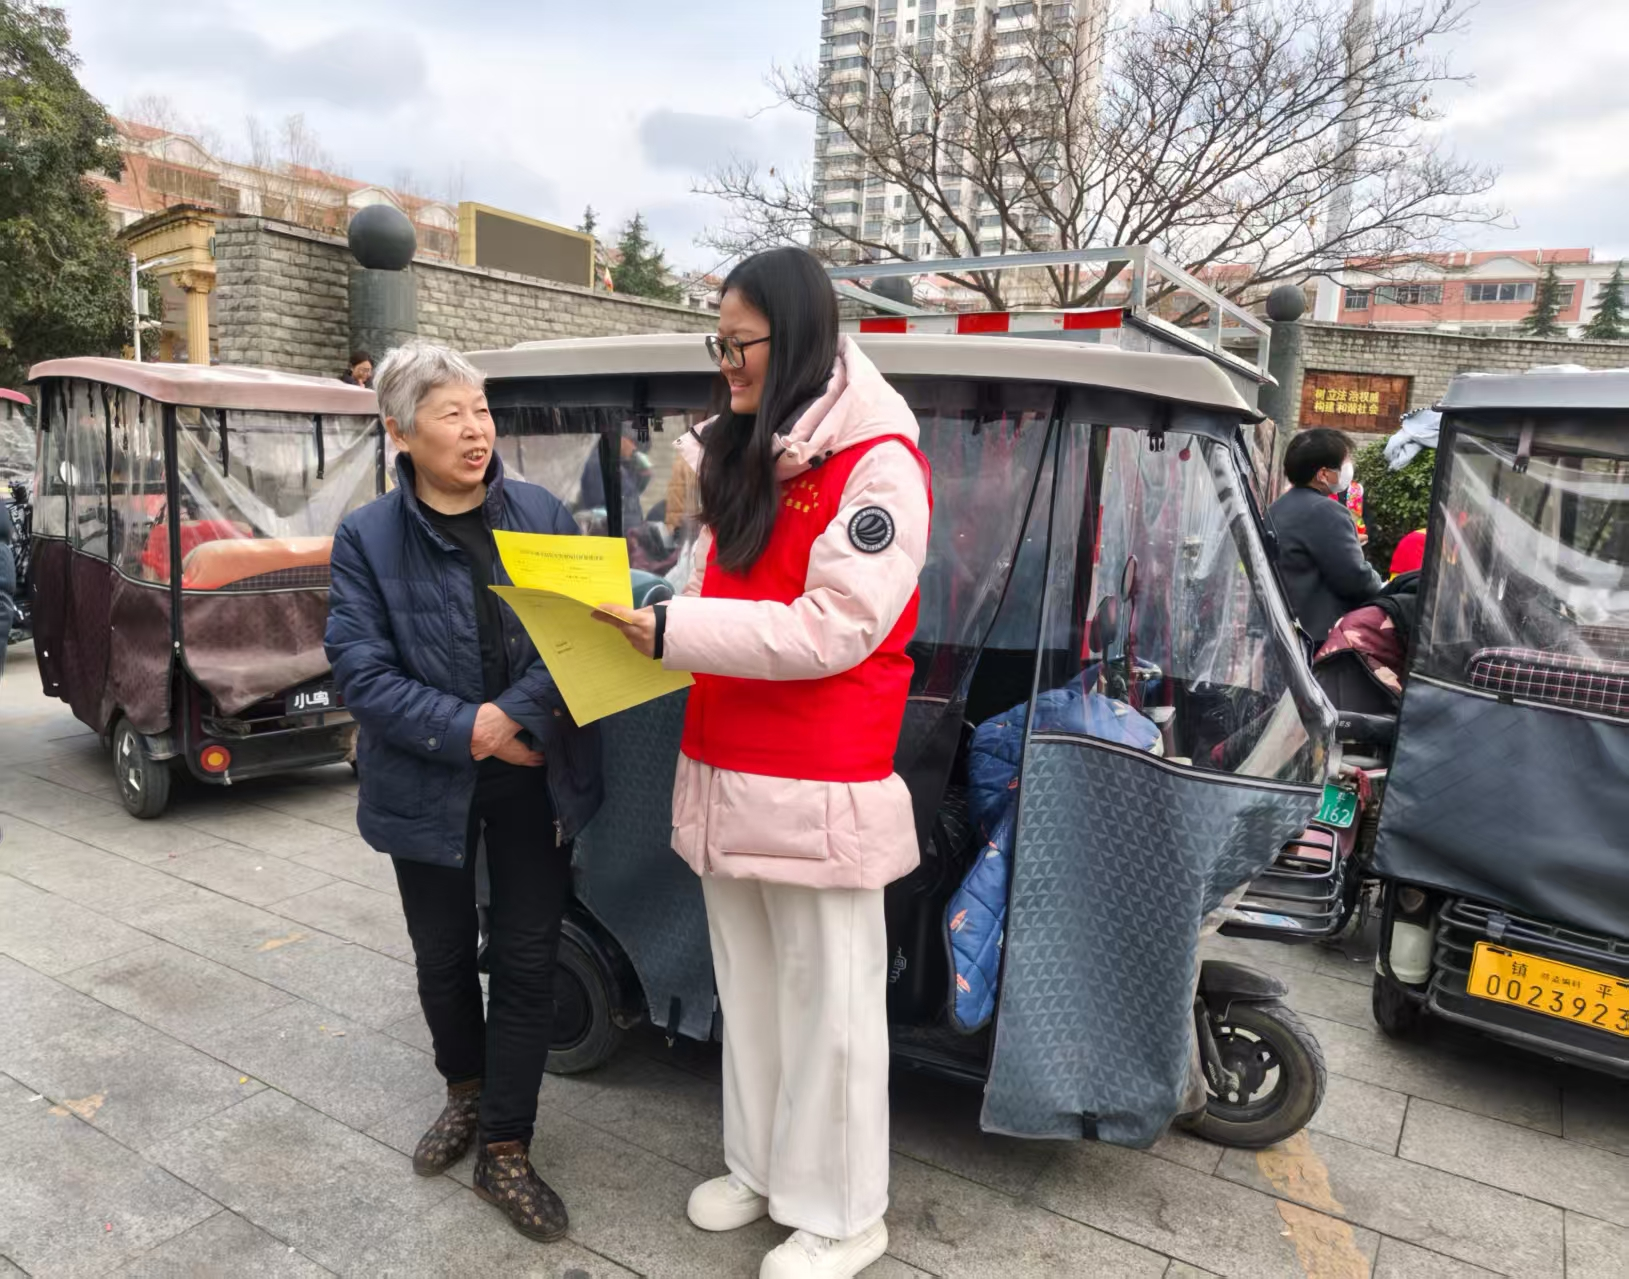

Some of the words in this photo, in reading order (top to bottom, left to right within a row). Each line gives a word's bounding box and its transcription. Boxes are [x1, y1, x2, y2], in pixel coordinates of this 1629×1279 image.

[1314, 400, 1379, 415] 构建和谐社会
[1511, 961, 1528, 979] 镇
[1596, 983, 1613, 1000] 平
[1486, 974, 1629, 1032] 0023923
